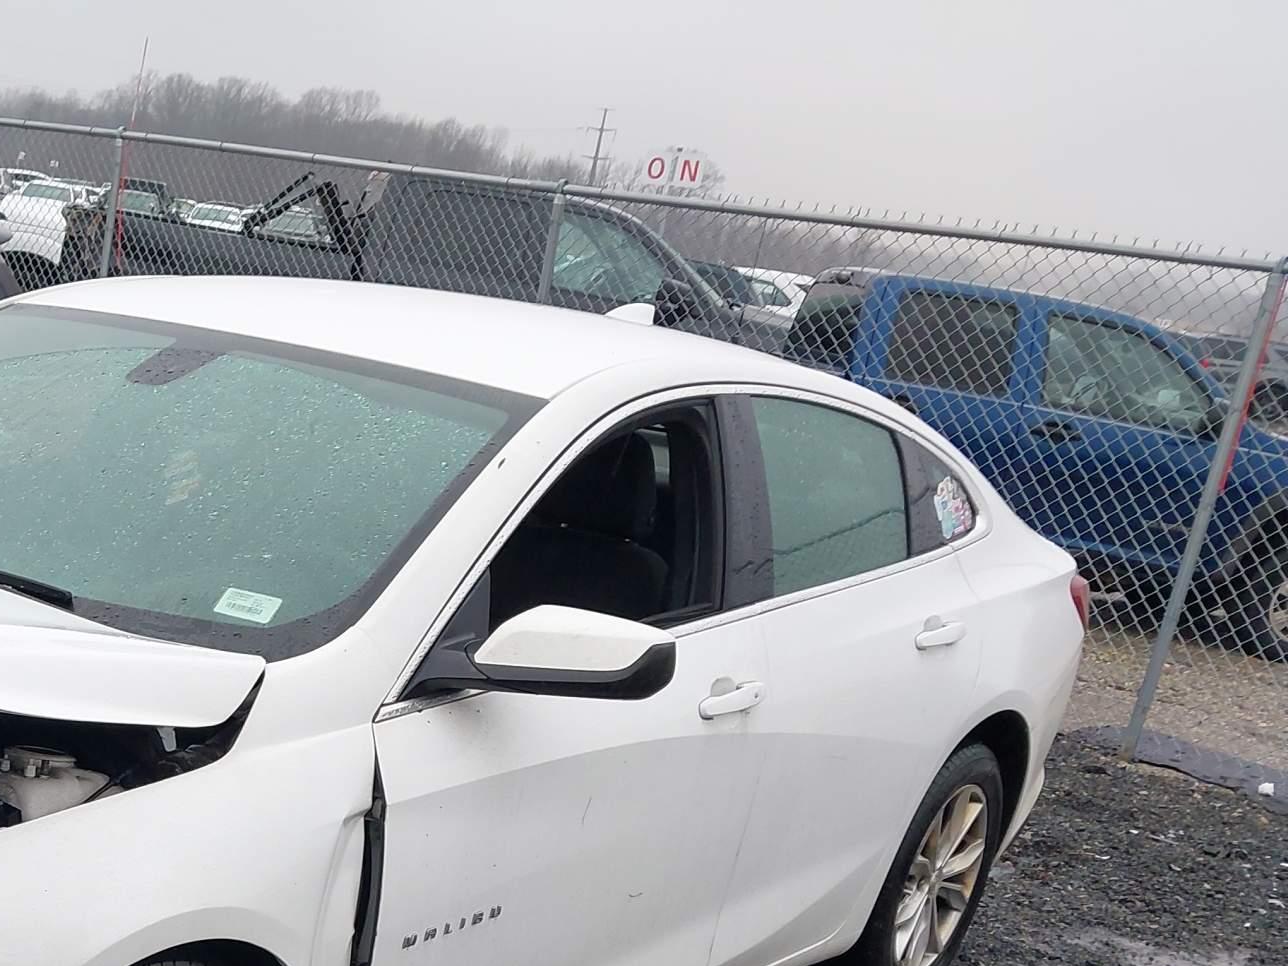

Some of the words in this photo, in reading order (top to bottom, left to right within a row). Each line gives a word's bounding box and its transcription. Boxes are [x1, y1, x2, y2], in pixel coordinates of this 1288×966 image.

[648, 157, 665, 179] O
[680, 160, 699, 182] N
[401, 905, 502, 949] MALIBU
